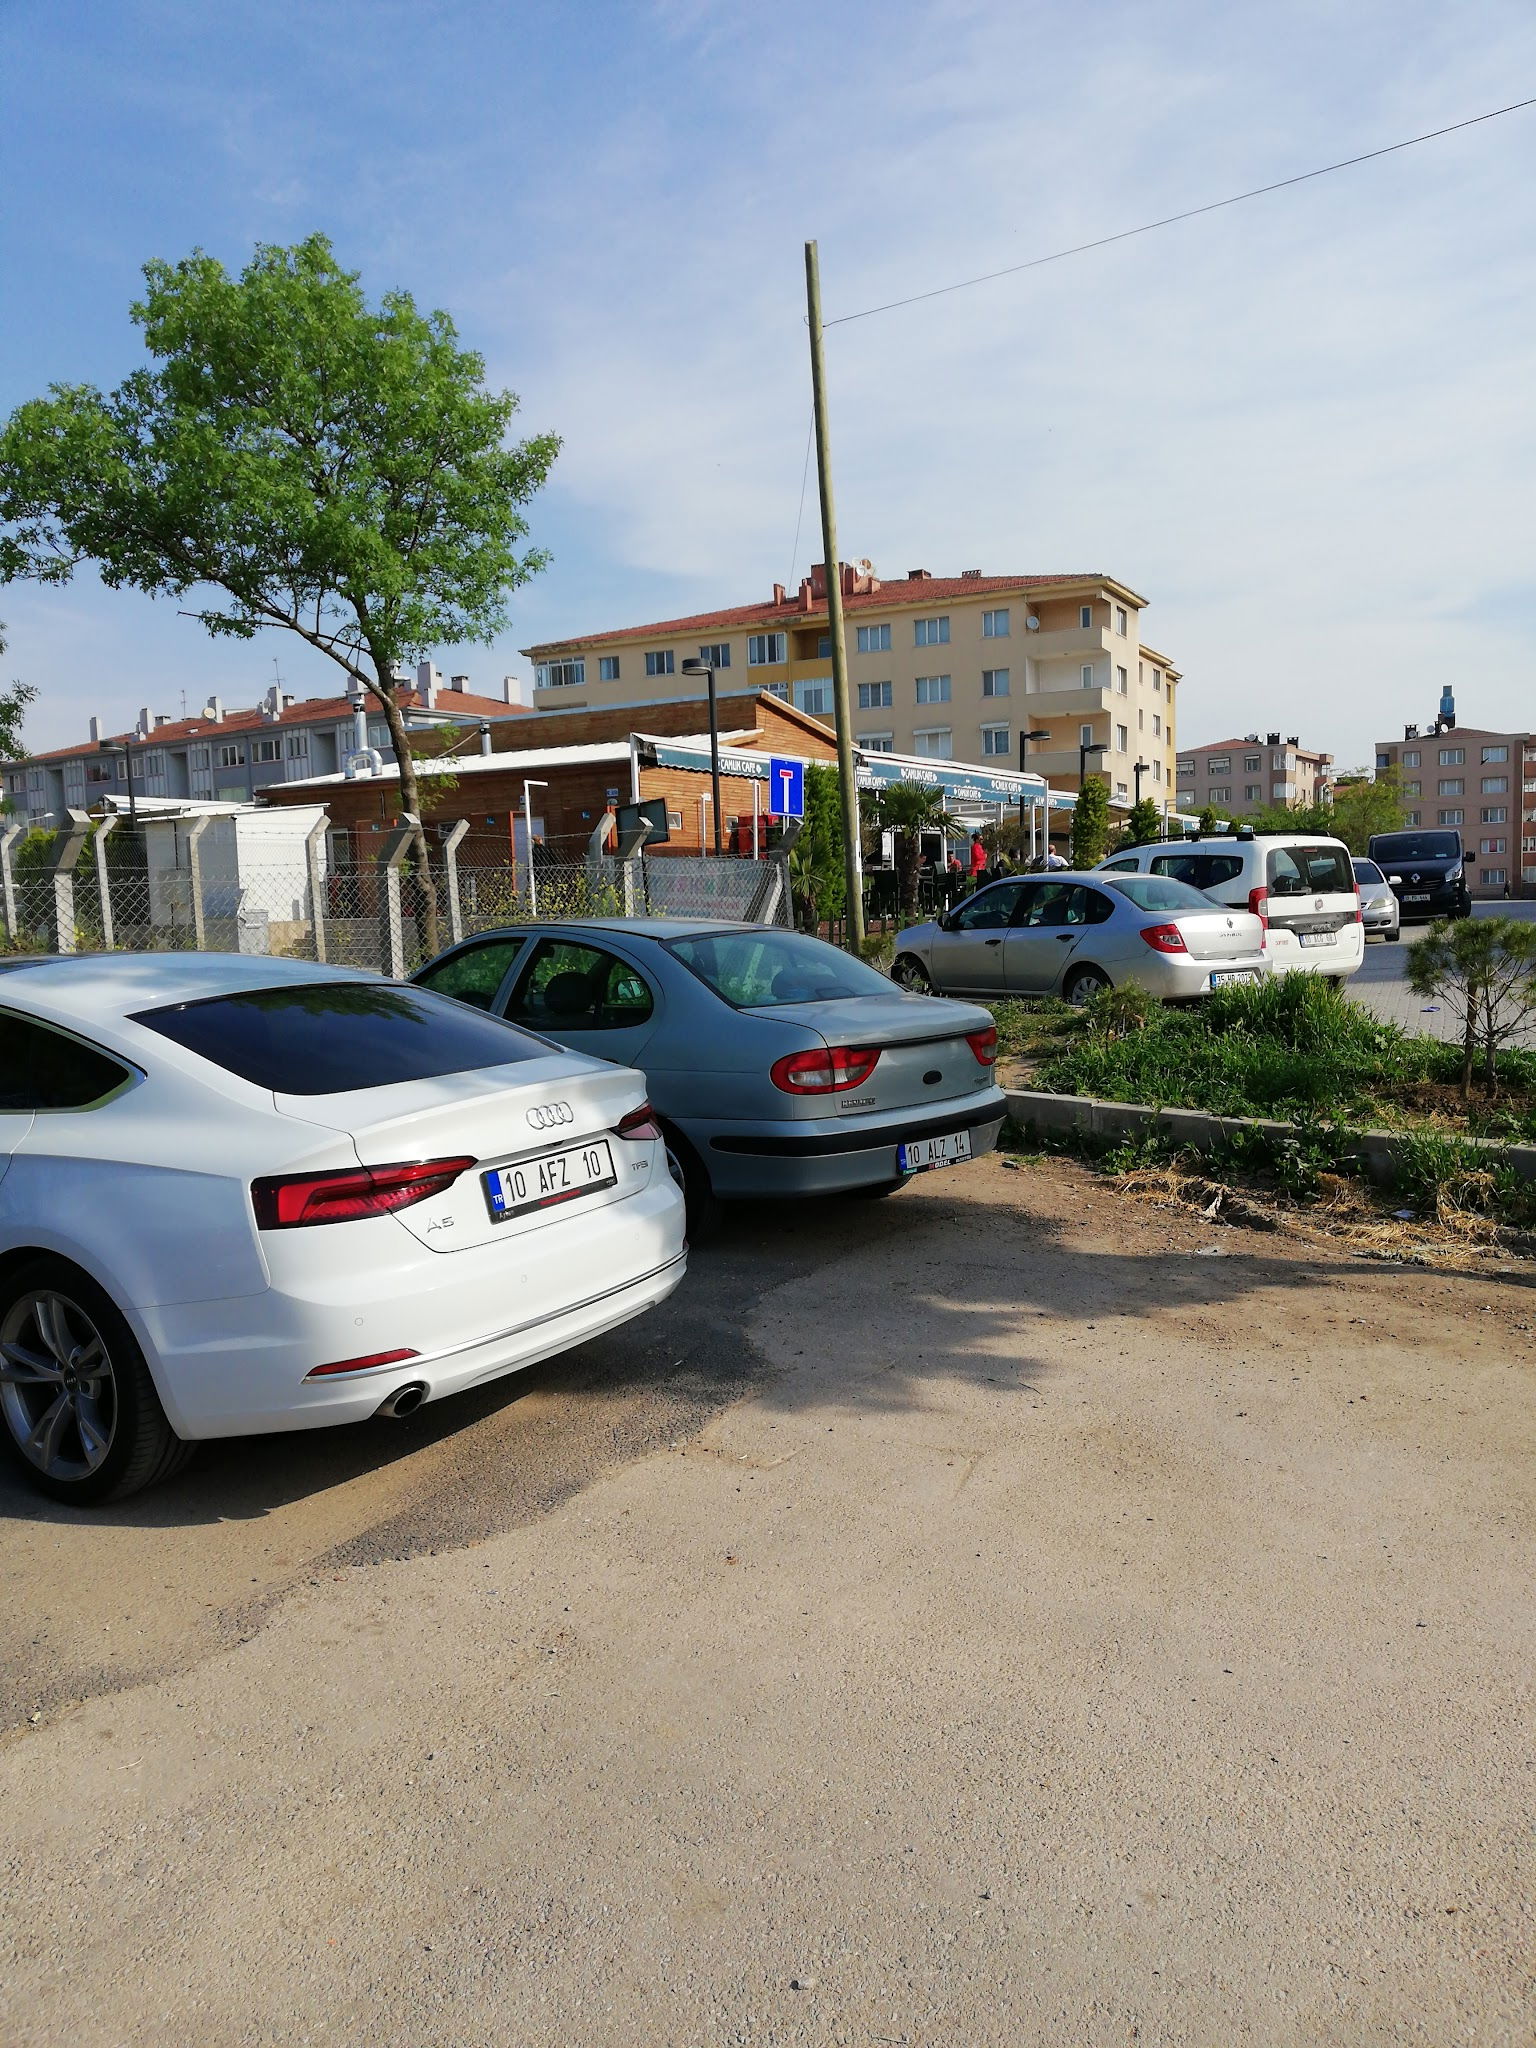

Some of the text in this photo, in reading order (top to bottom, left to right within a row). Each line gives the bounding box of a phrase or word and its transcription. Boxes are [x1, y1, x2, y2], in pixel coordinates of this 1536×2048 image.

[908, 1145, 920, 1166] 10
[928, 1138, 947, 1161] ALZ
[954, 1134, 965, 1154] 14
[505, 1170, 527, 1202] 10
[538, 1157, 571, 1193] AFZ
[582, 1150, 601, 1179] 10
[493, 1194, 504, 1205] TR
[426, 1216, 455, 1233] A5
